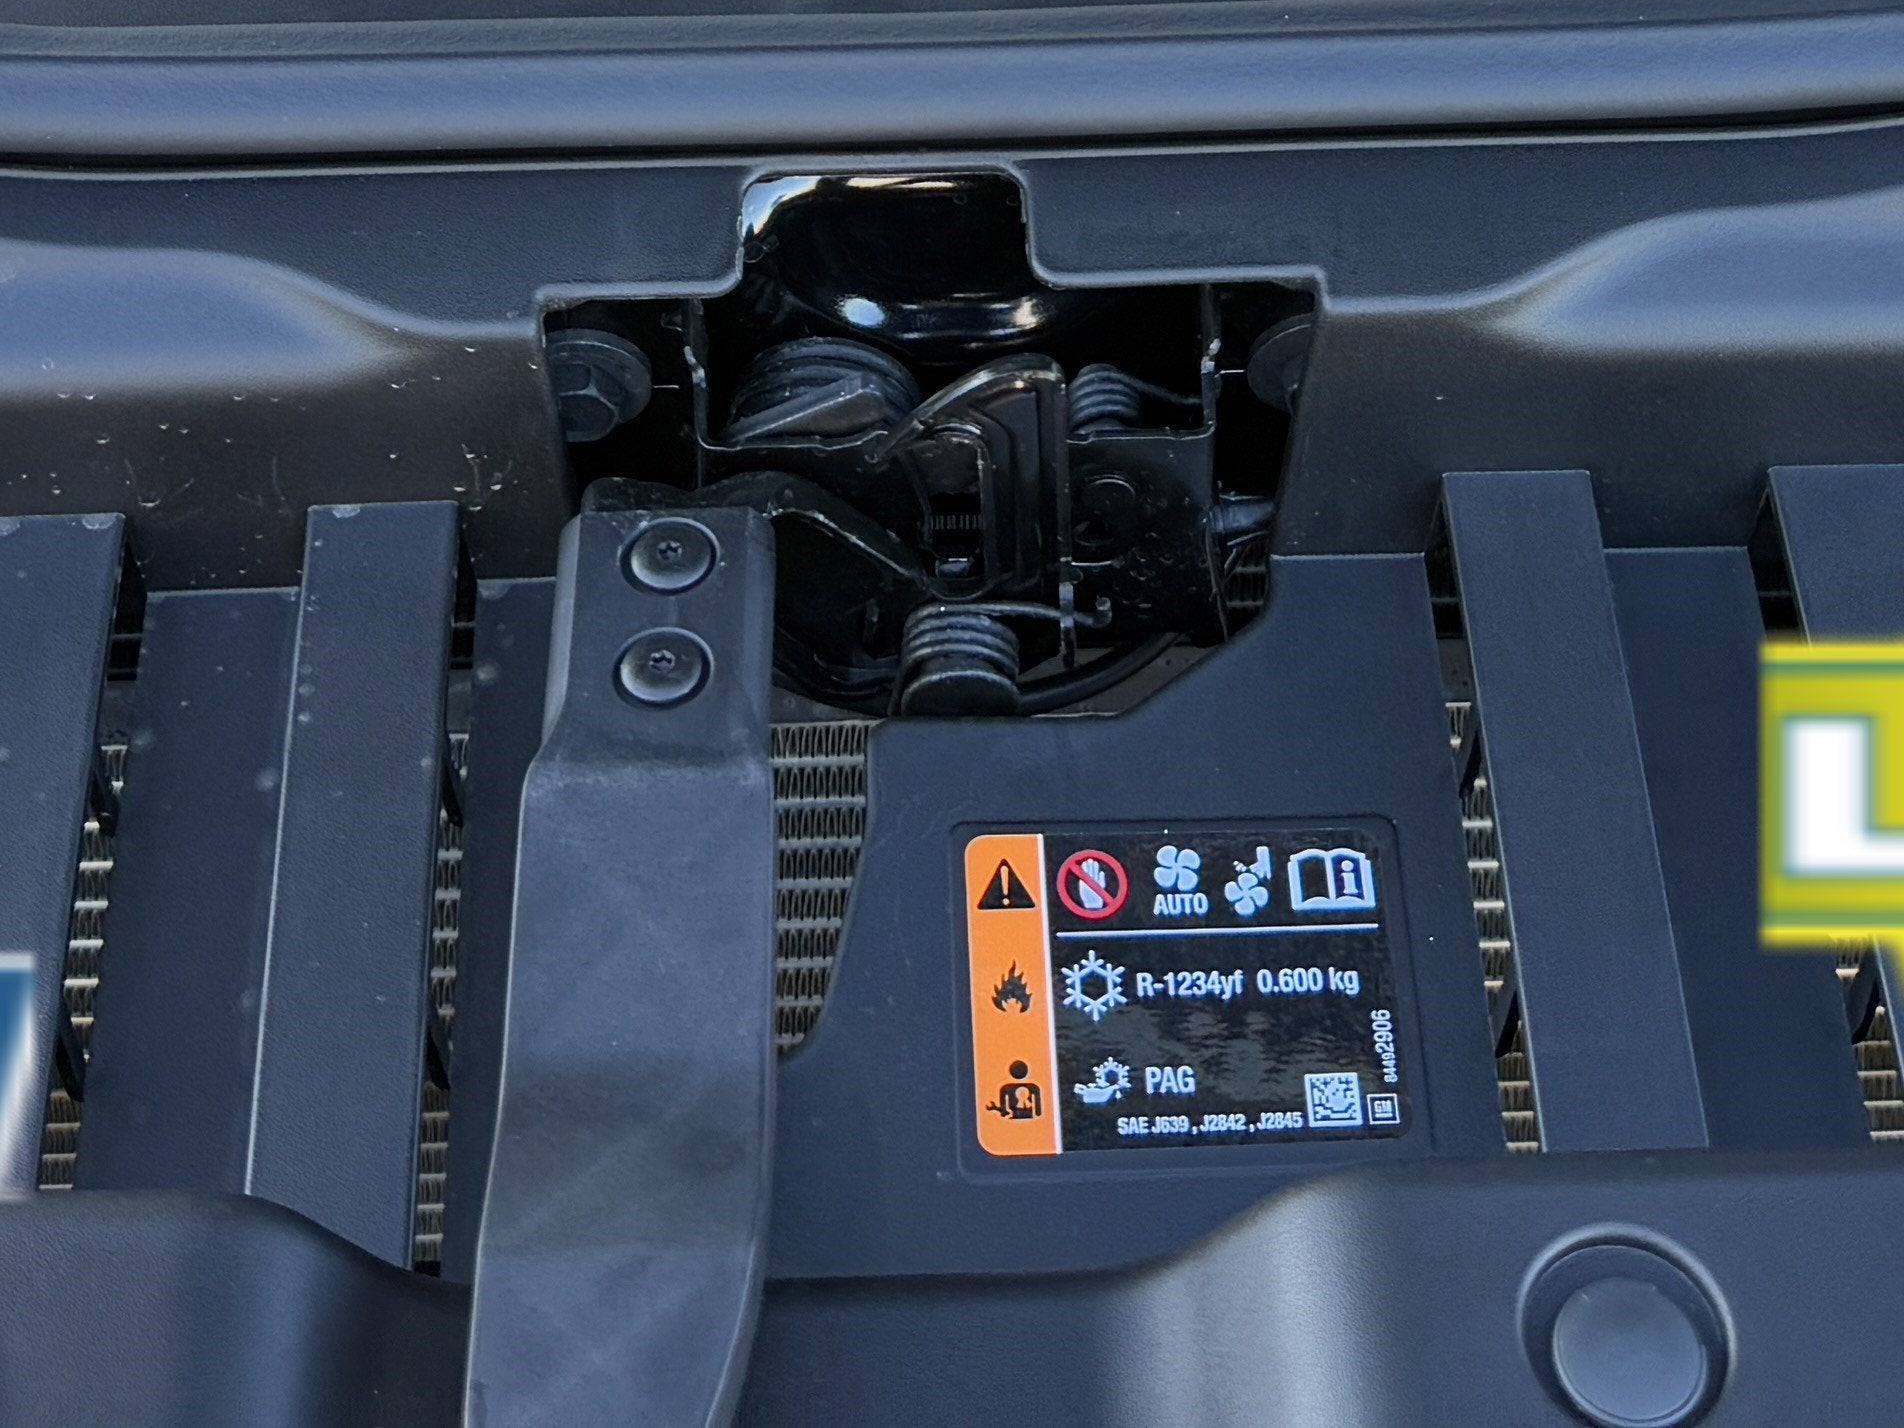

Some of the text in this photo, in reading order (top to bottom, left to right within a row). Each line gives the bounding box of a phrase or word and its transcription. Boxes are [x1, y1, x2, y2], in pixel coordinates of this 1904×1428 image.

[1153, 893, 1208, 915] AUTO
[1136, 966, 1360, 1000] R-1234yf 0.600 kg
[1370, 1009, 1398, 1084] 84492906
[1145, 1066, 1196, 1095] PAG
[1117, 1116, 1149, 1135] SAE
[1256, 1111, 1304, 1130] J2845
